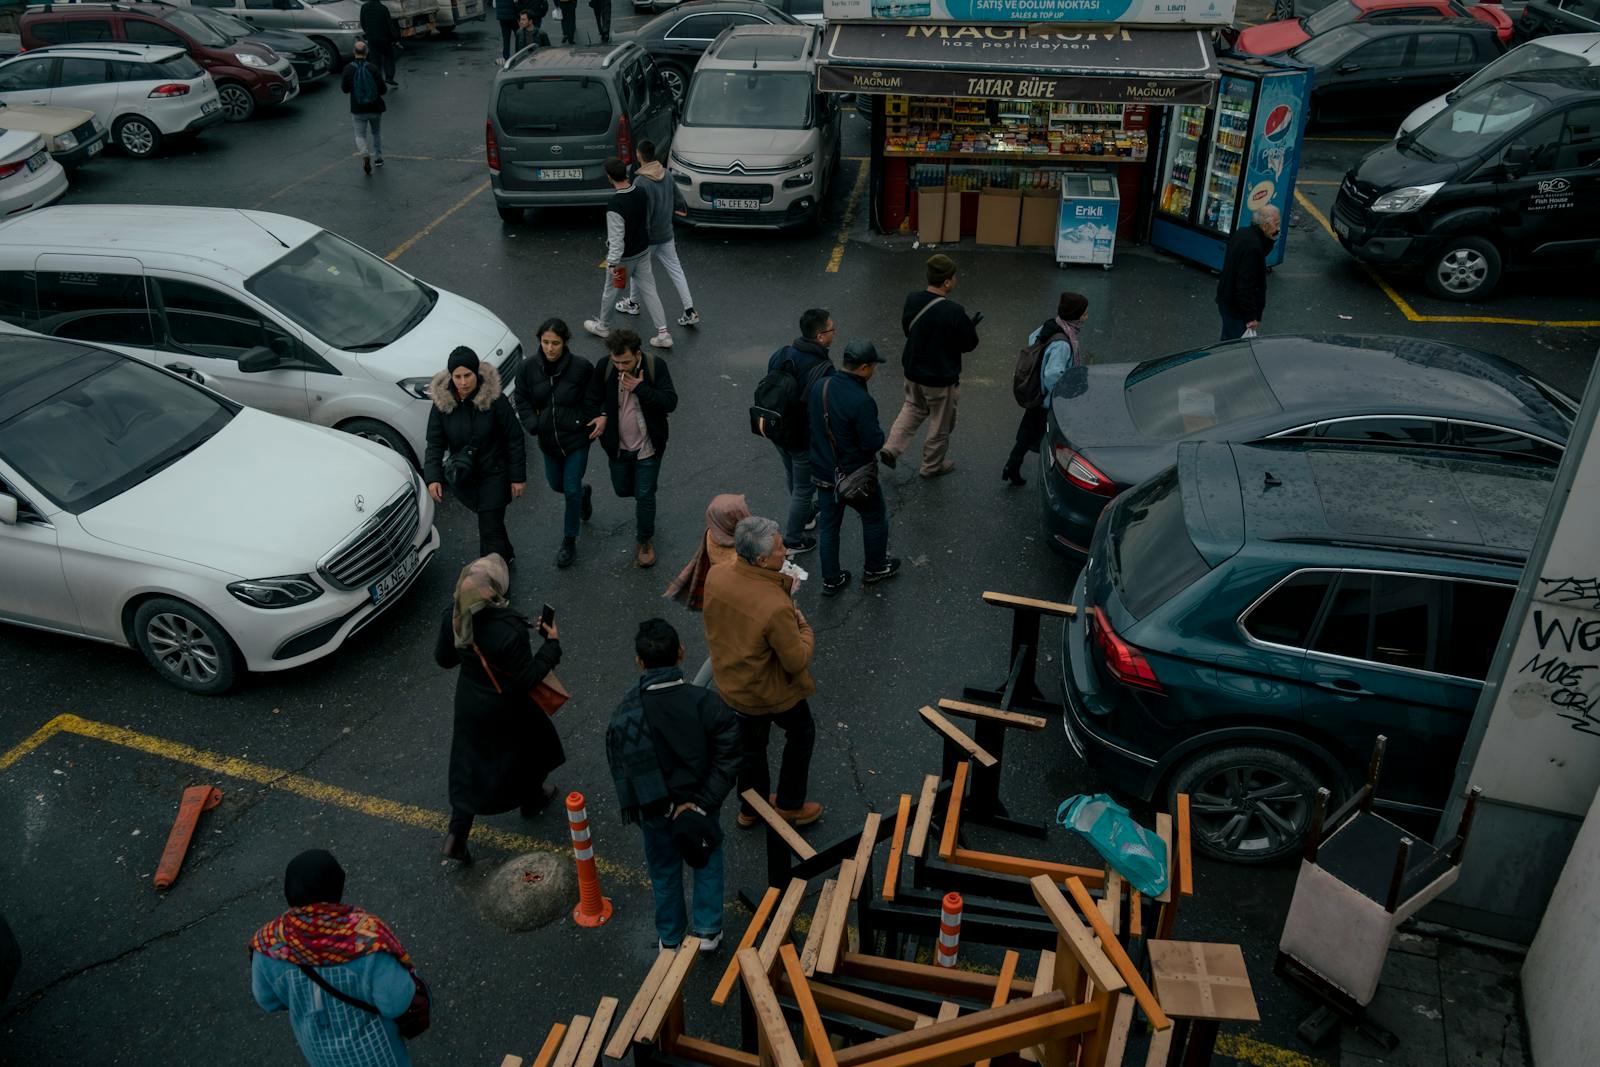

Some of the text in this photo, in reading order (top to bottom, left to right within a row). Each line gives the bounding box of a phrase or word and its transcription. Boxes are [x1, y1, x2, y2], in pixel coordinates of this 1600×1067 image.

[976, 0, 1100, 11] SATIŞ VE DOLUM NOKTASI
[942, 40, 1091, 51] haz peşindeysen
[853, 76, 902, 88] MAGNUM
[967, 77, 1058, 98] TATAR BÜFE
[1126, 86, 1176, 97] MAGNUM
[716, 199, 726, 208] 34
[1075, 205, 1104, 217] Erikli
[377, 579, 390, 597] 34
